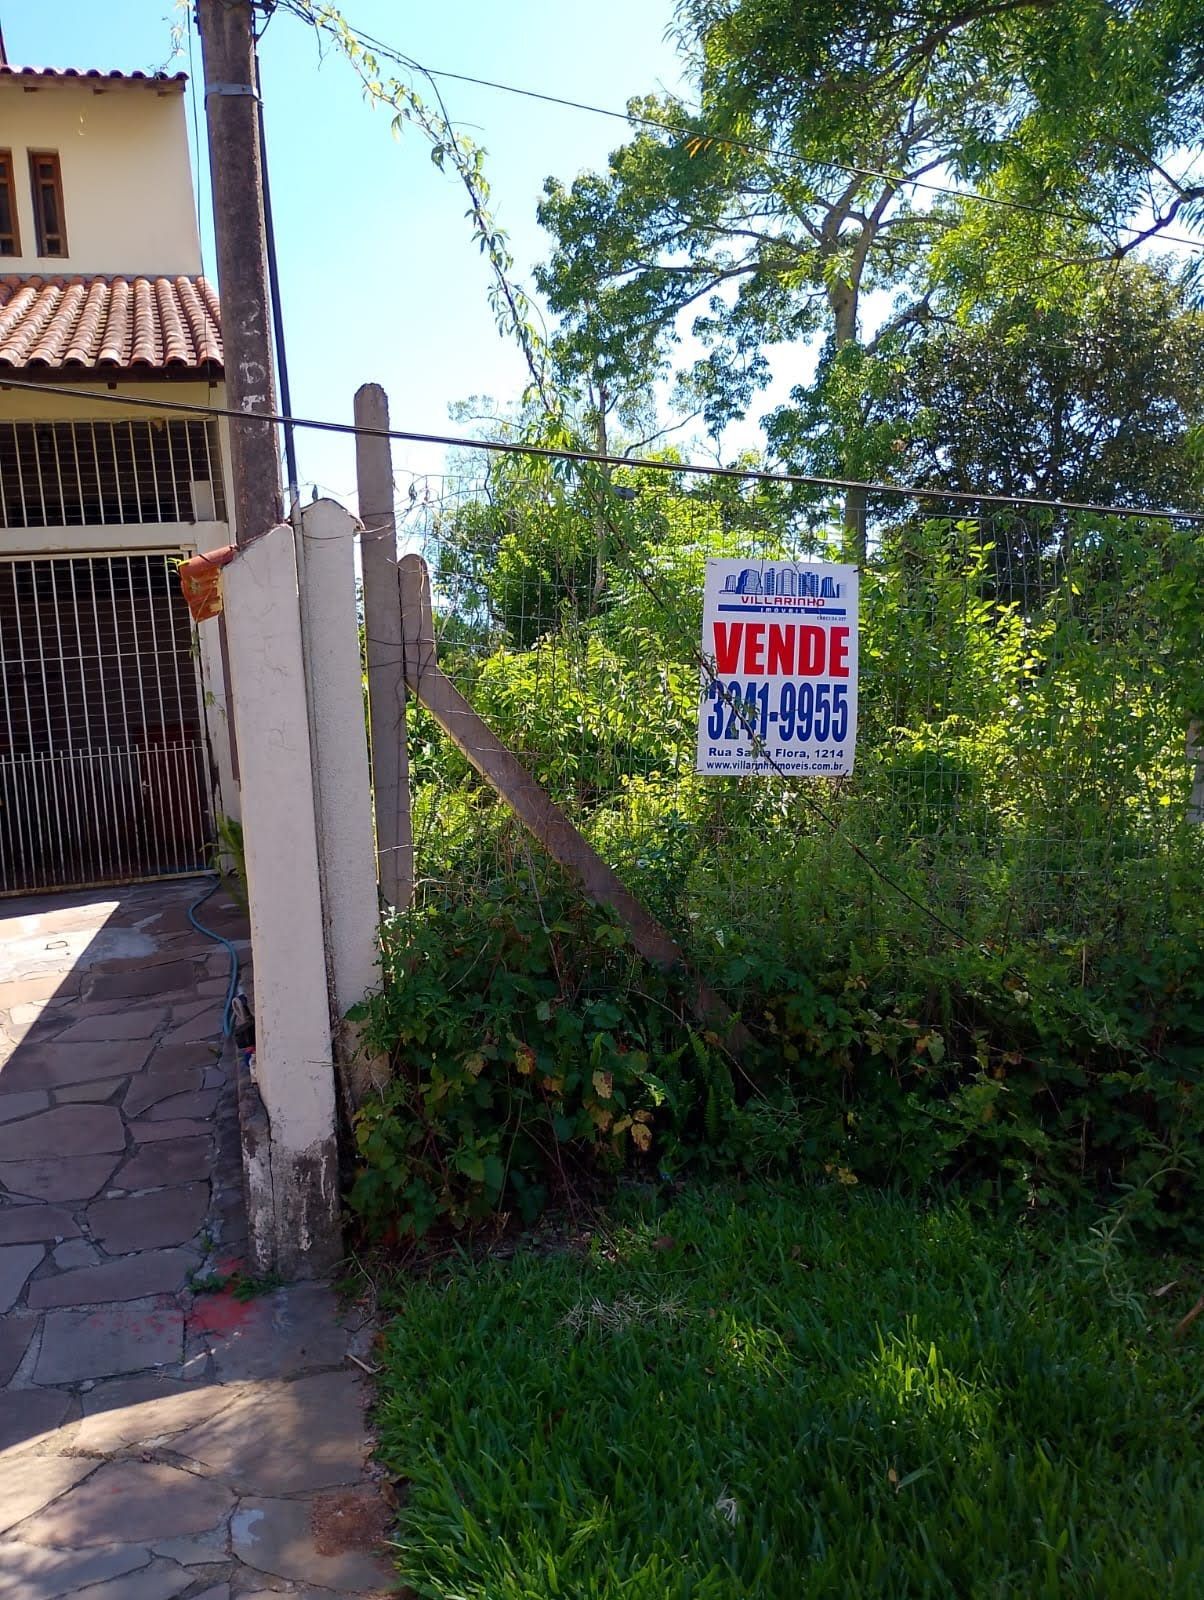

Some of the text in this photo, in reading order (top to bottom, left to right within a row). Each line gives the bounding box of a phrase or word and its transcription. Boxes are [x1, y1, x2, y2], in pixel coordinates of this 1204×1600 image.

[741, 595, 825, 607] VILLARINHO
[713, 622, 850, 677] VENDE
[708, 681, 848, 742] 3241-9955
[708, 748, 843, 760] Rua Sata Flora, 1214
